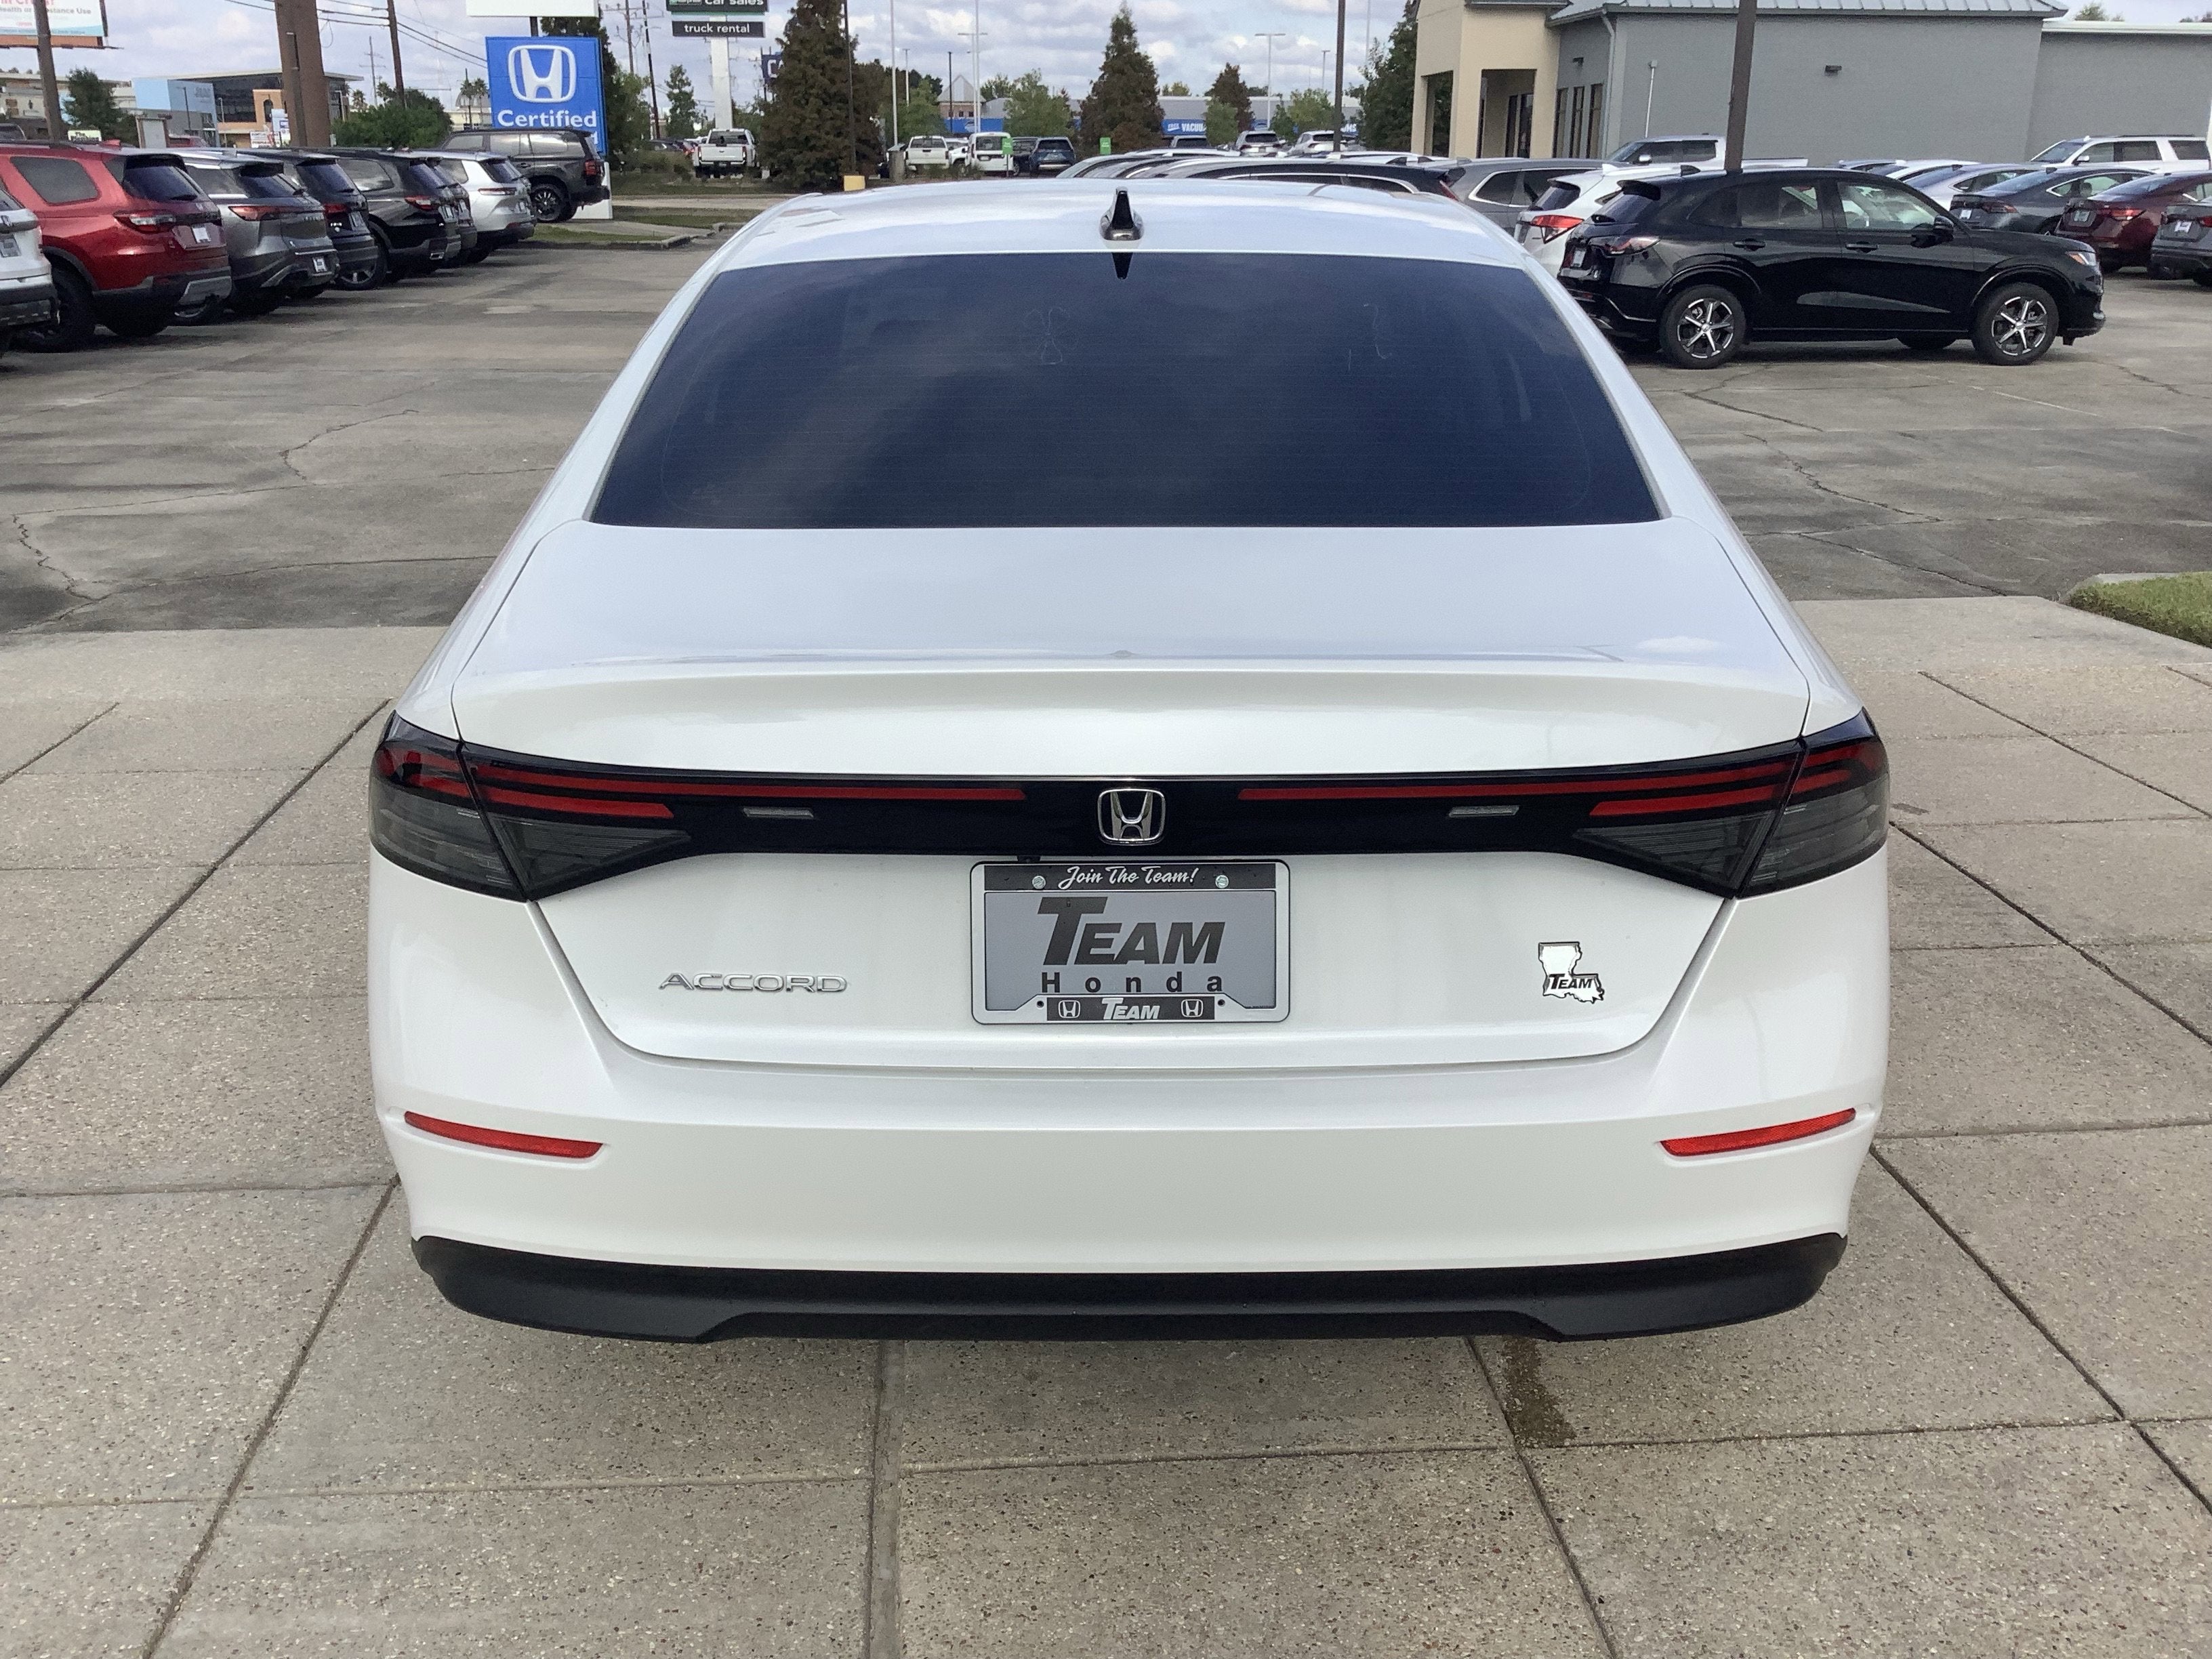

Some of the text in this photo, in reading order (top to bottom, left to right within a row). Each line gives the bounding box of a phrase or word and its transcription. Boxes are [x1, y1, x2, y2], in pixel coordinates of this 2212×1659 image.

[684, 23, 750, 33] truck rental
[497, 109, 597, 127] Certified
[1181, 123, 1206, 132] VACUU
[1058, 865, 1200, 890] Join The Team!
[1037, 896, 1226, 966] TEAM
[658, 972, 848, 993] ACCORD
[1042, 971, 1223, 994] Honda
[1549, 973, 1593, 989] TEAM
[1101, 998, 1161, 1020] TEAM
